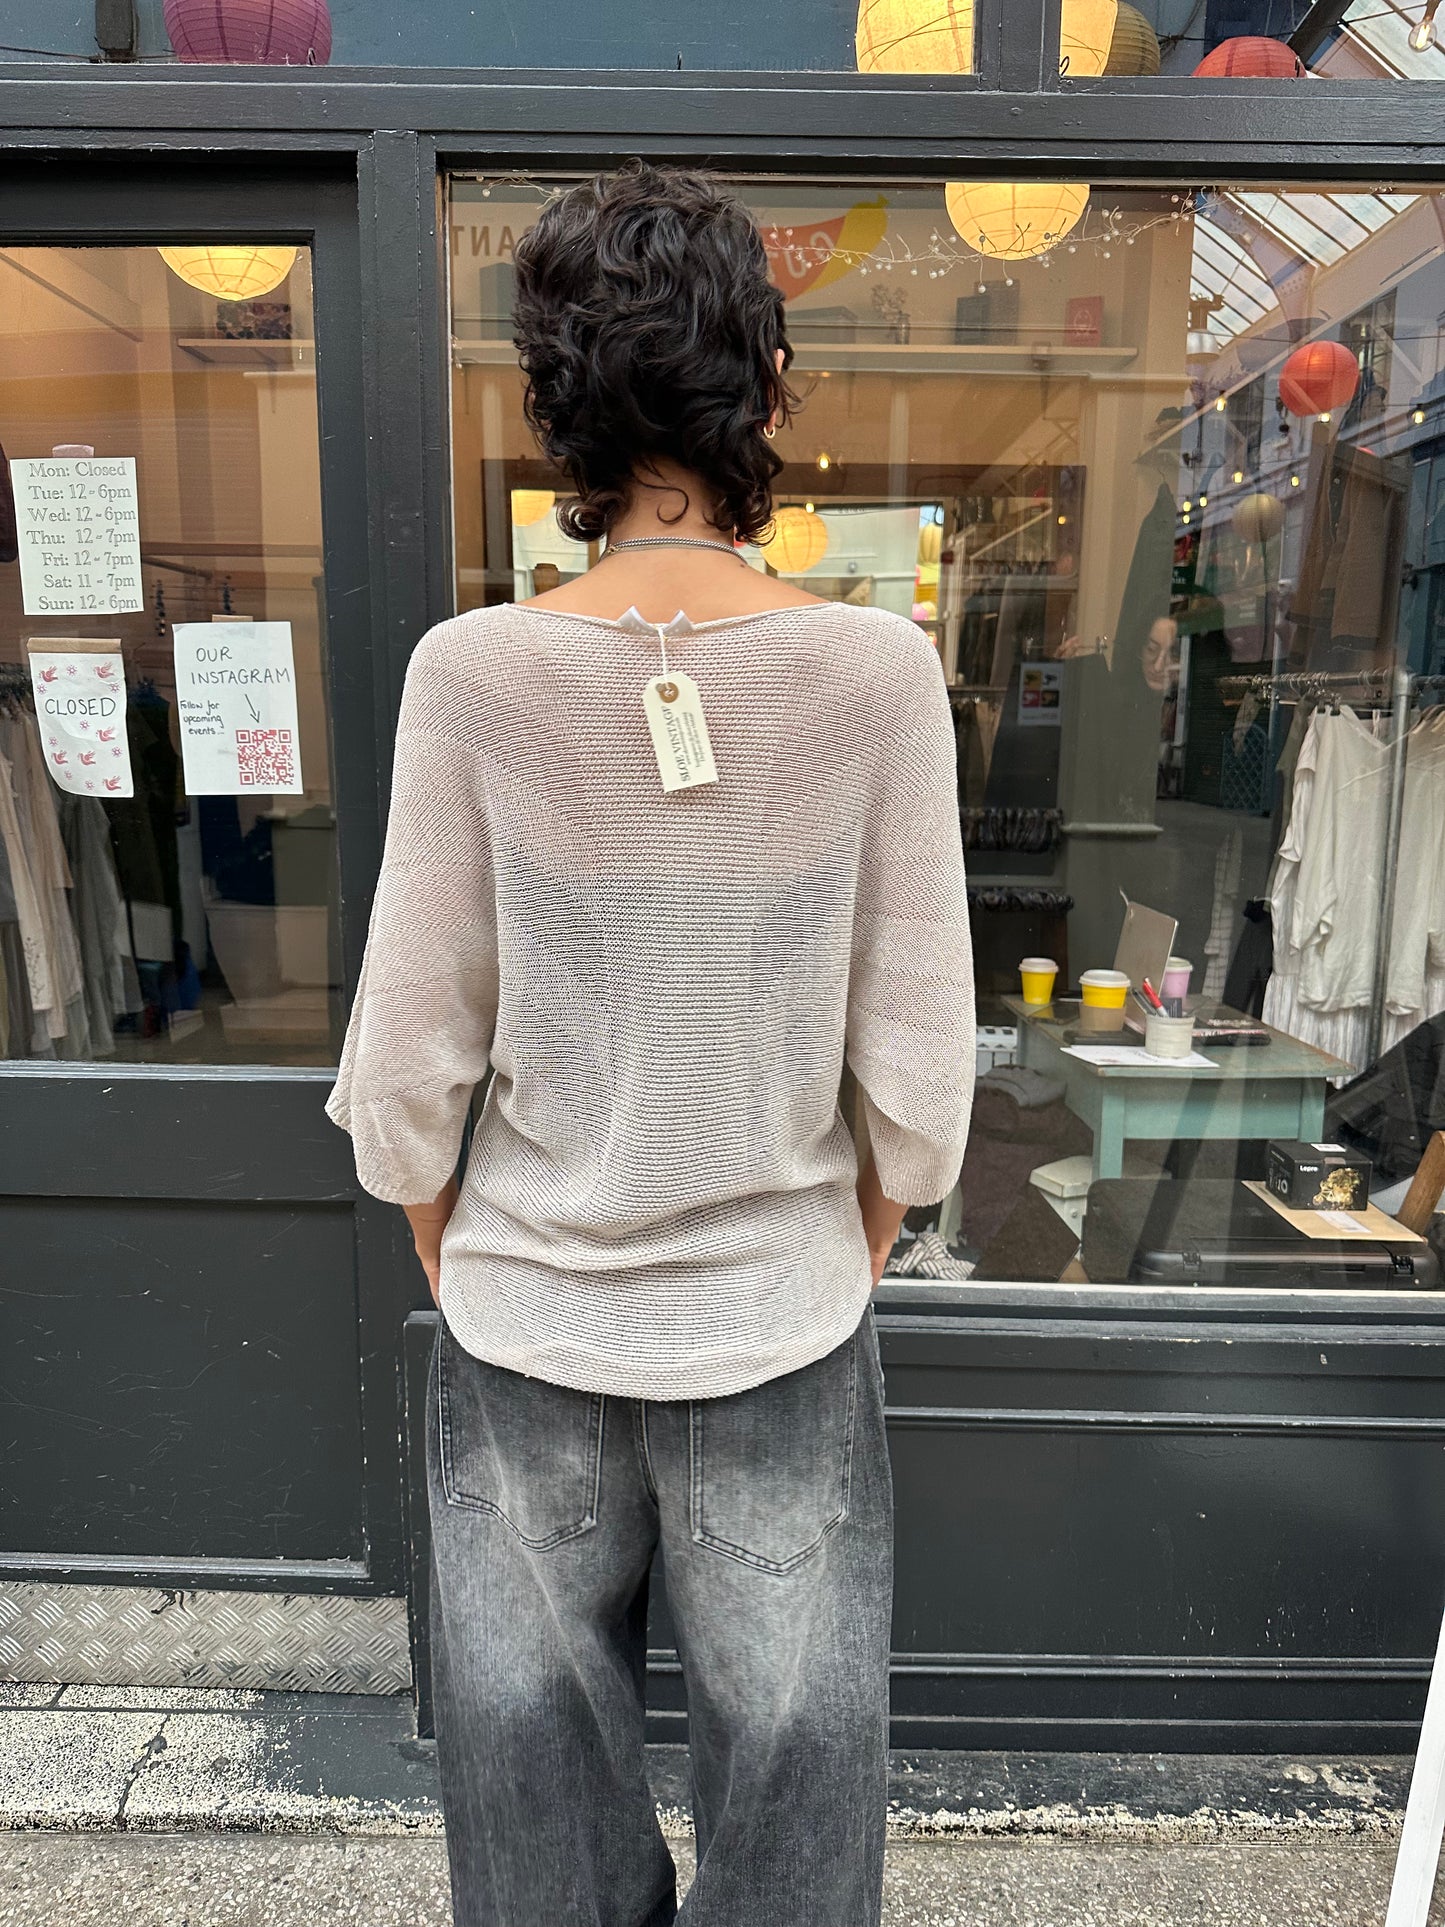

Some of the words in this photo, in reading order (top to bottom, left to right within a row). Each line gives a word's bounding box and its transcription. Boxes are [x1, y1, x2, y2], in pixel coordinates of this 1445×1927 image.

[29, 462, 70, 477] Mon:
[75, 461, 127, 477] Closed
[28, 485, 64, 500] Tue:
[27, 507, 71, 522] Wed:
[26, 530, 66, 544] Thu:
[41, 552, 69, 567] Fri:
[44, 574, 72, 588] Sat:
[38, 595, 74, 610] Sun:
[196, 646, 233, 662] OUR
[190, 667, 291, 685] INSTAGRAM
[44, 697, 116, 717] CLOSED
[179, 700, 203, 710] Follow
[206, 700, 220, 715] for
[183, 714, 224, 729] upcoming
